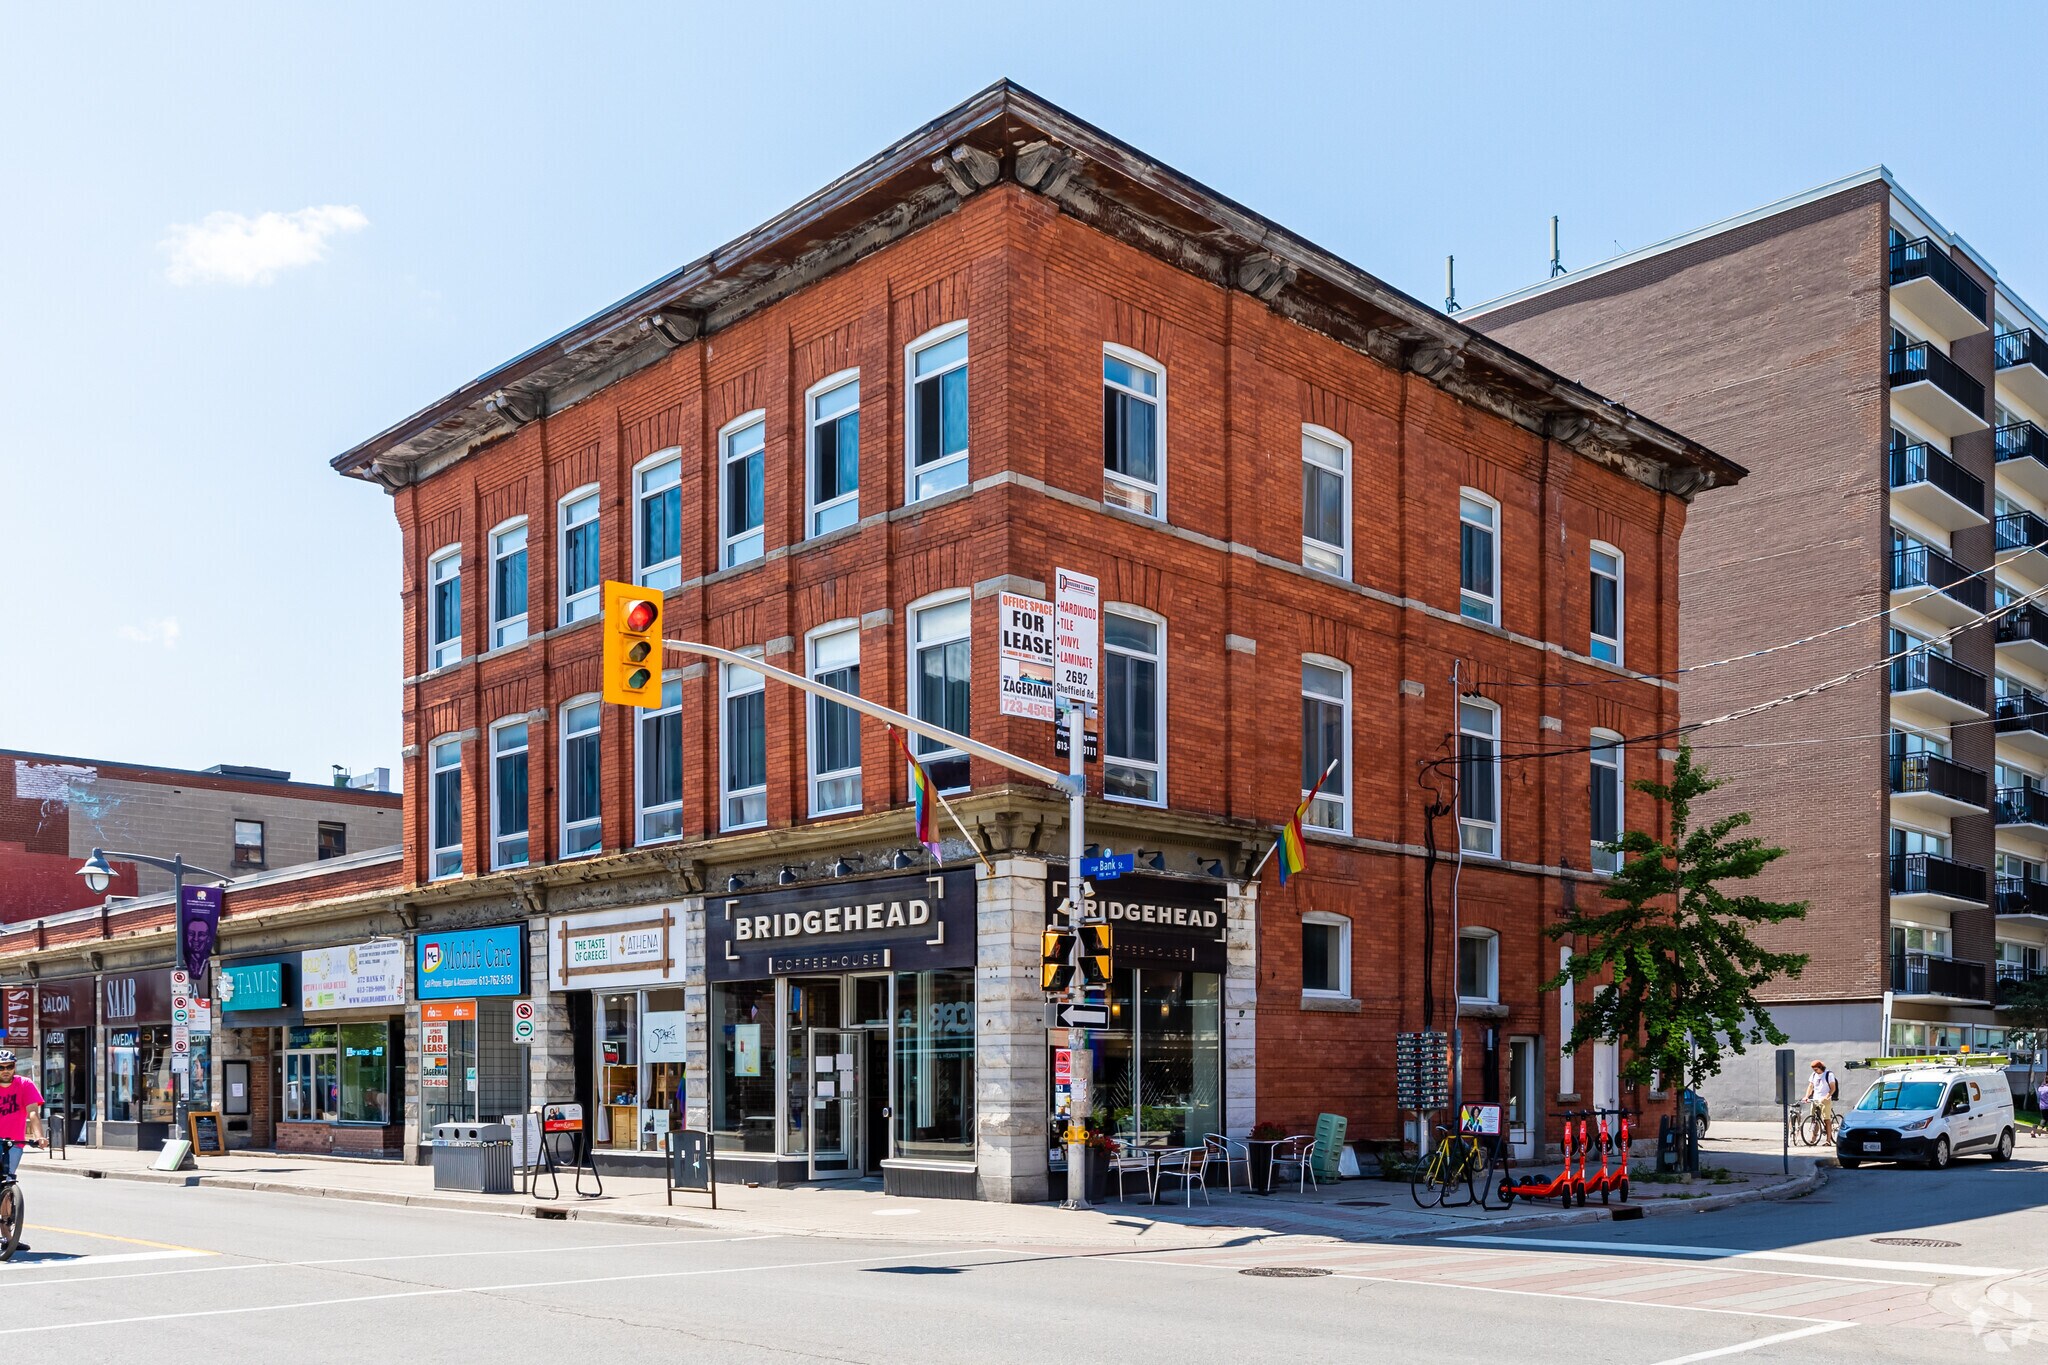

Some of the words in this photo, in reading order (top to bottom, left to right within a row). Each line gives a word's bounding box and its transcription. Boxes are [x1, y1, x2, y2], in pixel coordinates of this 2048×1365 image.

[1003, 595, 1028, 610] OFFICE
[1030, 600, 1052, 616] SPACE
[1060, 600, 1097, 620] HARDWOOD
[1013, 610, 1044, 633] FOR
[1060, 618, 1073, 631] TILE
[1004, 630, 1052, 656] LEASE
[1060, 634, 1079, 650] VINYL
[1060, 651, 1093, 669] LAMINATE
[1066, 669, 1087, 686] 2692
[1003, 679, 1053, 699] ZAGERMAN
[1056, 683, 1085, 697] Sheffield
[1087, 689, 1096, 699] Rd.
[1003, 699, 1053, 718] 723-4545
[1100, 859, 1116, 870] Bank
[736, 899, 930, 940] BRIDGEHEAD
[1084, 900, 1217, 927] RIDGEHEAD
[575, 940, 586, 950] THE
[588, 938, 605, 950] TASTE
[628, 934, 658, 950] ATHENA
[428, 952, 438, 963] MC
[444, 940, 481, 970] Mobile
[485, 938, 512, 968] Care
[575, 952, 582, 962] OF
[583, 950, 608, 961] GREECE!
[1116, 944, 1188, 958] FFEEHOUSE
[776, 953, 880, 970] COFFEEHOUSE
[236, 970, 278, 995] TAMIS
[479, 975, 513, 986] 613-762-5151
[43, 995, 70, 1013] SALON
[107, 978, 137, 1019] SAAB
[8, 990, 29, 1037] SAAB
[47, 1032, 65, 1044] AVEDA
[112, 1033, 134, 1046] AVEDA
[427, 1035, 443, 1043] FOR
[423, 1044, 447, 1052] LEASE
[423, 1068, 448, 1076] ZAGERMAN
